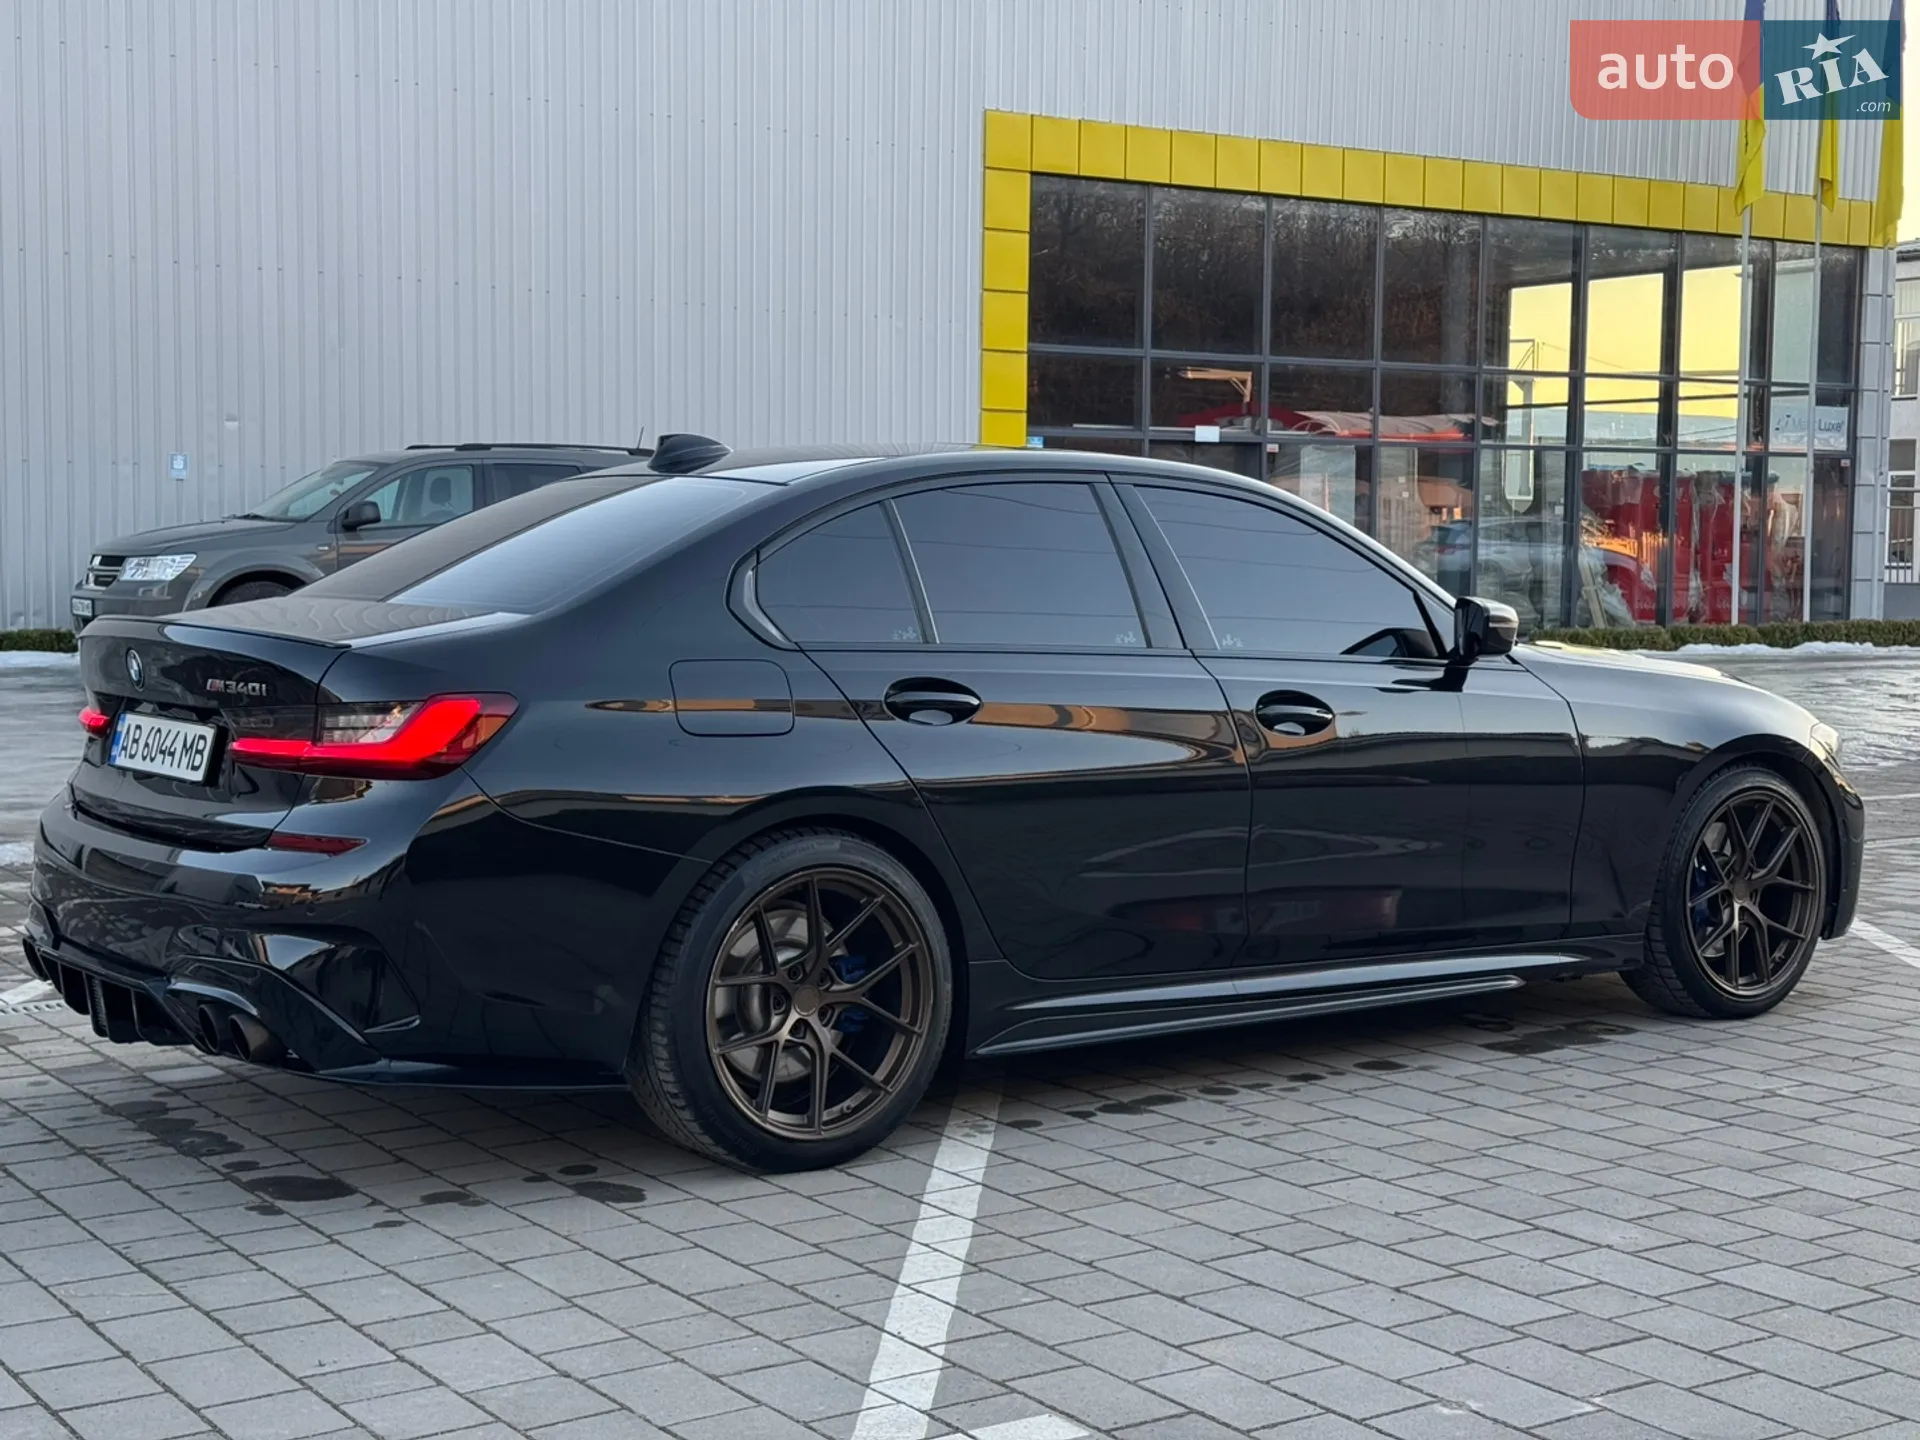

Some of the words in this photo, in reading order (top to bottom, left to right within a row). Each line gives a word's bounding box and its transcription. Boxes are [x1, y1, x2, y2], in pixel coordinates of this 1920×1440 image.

[118, 723, 142, 760] AB
[141, 725, 180, 768] 6044
[177, 731, 208, 772] MB
